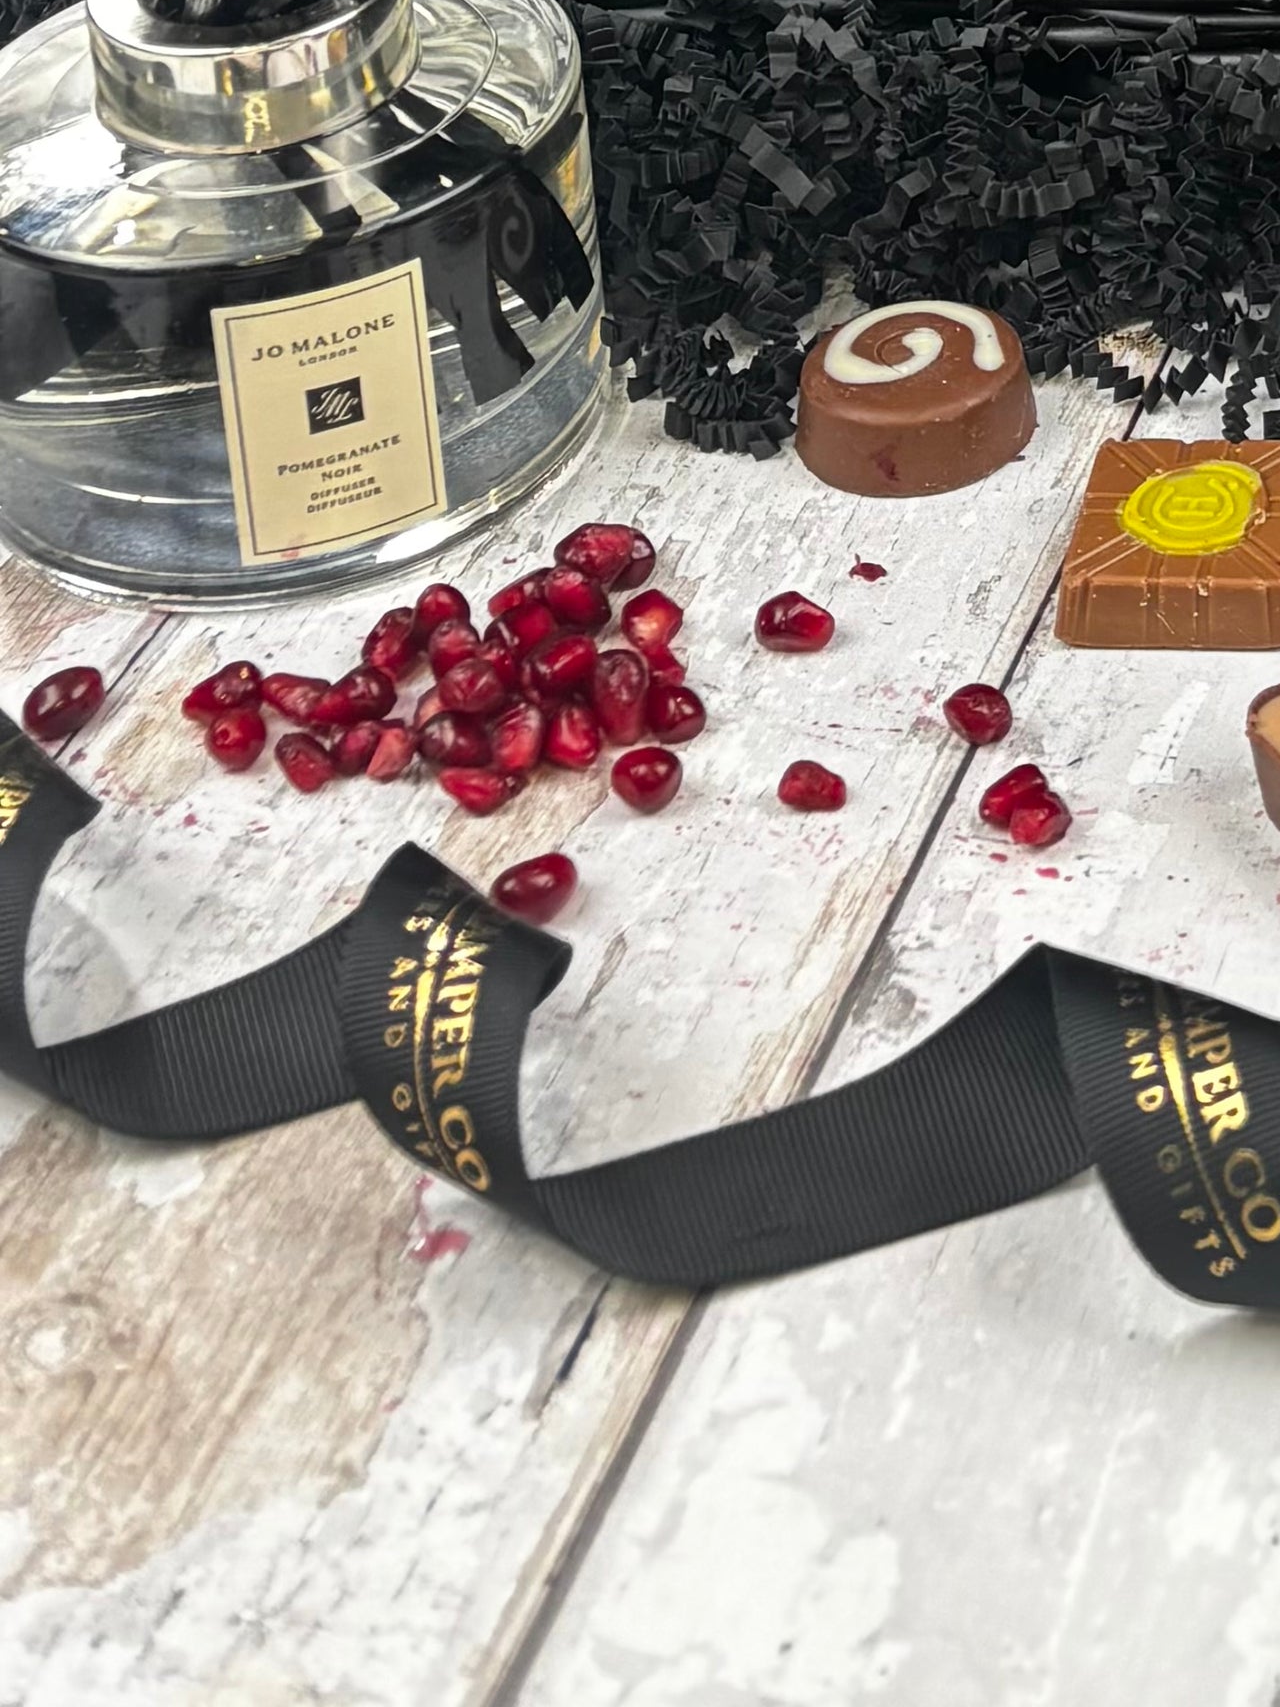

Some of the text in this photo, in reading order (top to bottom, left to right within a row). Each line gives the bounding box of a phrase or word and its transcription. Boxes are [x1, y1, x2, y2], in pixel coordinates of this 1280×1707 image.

[251, 313, 395, 362] JO MALONE
[277, 434, 401, 476] POMEGRANATE
[306, 486, 383, 513] DIFFUSEUR
[310, 476, 376, 501] DIFFUSER
[439, 1103, 491, 1192] CO
[1124, 1026, 1165, 1114] AND
[1156, 1143, 1237, 1279] GIFTS
